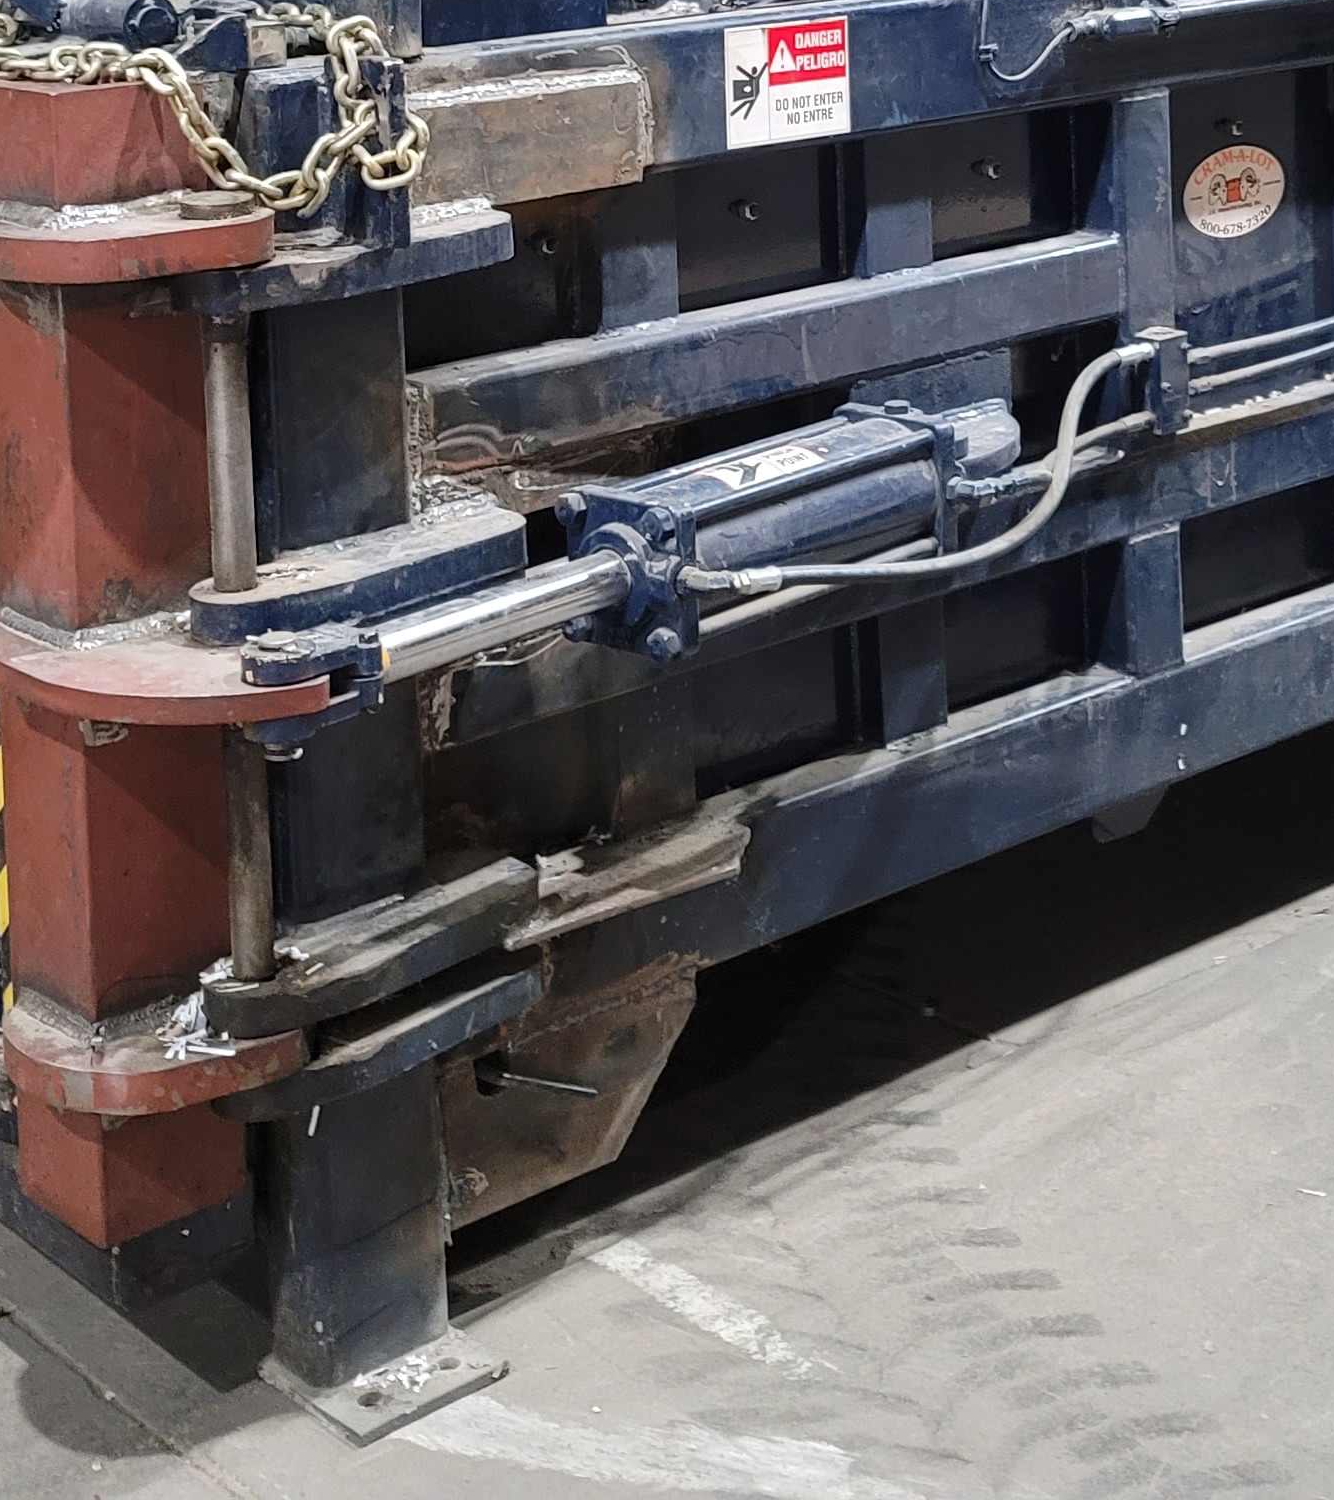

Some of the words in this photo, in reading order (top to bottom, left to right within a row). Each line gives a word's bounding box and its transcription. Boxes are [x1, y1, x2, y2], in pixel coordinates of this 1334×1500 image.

[795, 29, 842, 49] DANGER
[795, 50, 845, 71] PELIGRO
[775, 99, 789, 111] DO
[792, 95, 811, 109] NOT
[814, 91, 844, 107] ENTER
[786, 112, 801, 125] NO
[803, 107, 834, 123] ENTRE
[1194, 149, 1274, 185] CRAM-A-LOT
[1200, 205, 1271, 234] 800-678-7320
[776, 452, 810, 467] POINT
